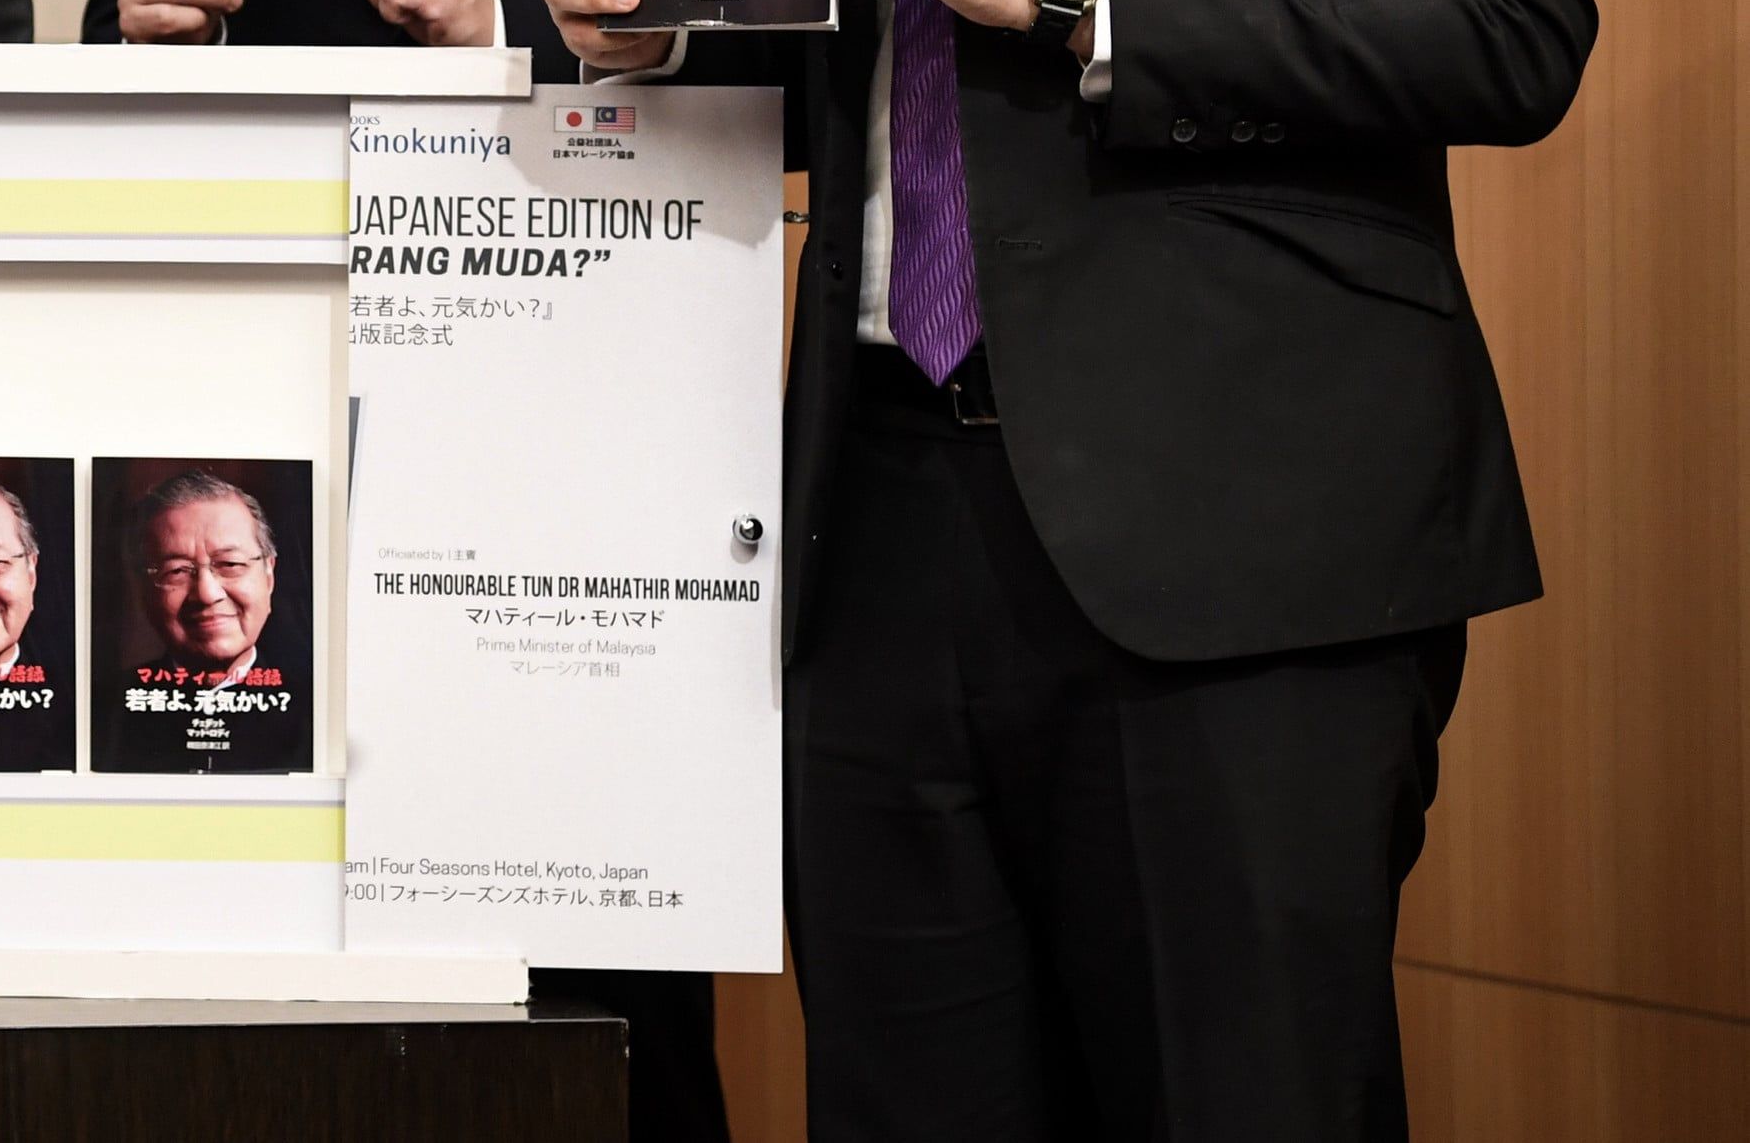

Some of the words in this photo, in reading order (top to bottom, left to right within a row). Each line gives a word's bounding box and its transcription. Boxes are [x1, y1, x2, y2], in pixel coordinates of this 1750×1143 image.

[350, 196, 515, 237] JAPANESE
[528, 198, 652, 239] EDITION
[665, 200, 703, 240] OF
[350, 246, 449, 275] RANG
[374, 573, 404, 594] THE
[411, 574, 516, 596] HONOURABLE
[522, 576, 552, 597] TUN
[559, 577, 578, 597] DR
[585, 577, 669, 599] MAHATHIR
[676, 580, 759, 601] MOHAMAD
[466, 608, 662, 628] マハティール・モハマド
[475, 634, 516, 654] Prime
[519, 636, 575, 656] Minister
[578, 638, 593, 655] of
[596, 640, 657, 658] Malaysia
[137, 667, 284, 687] マハティール語録
[508, 659, 622, 678] マレーシア首相
[124, 690, 292, 715] 若者よ、元気かい？
[379, 857, 415, 875] Four
[419, 858, 490, 876] Seasons
[493, 859, 542, 878] Hotel,
[546, 861, 596, 881] Kyoto,
[600, 862, 649, 883] Japan
